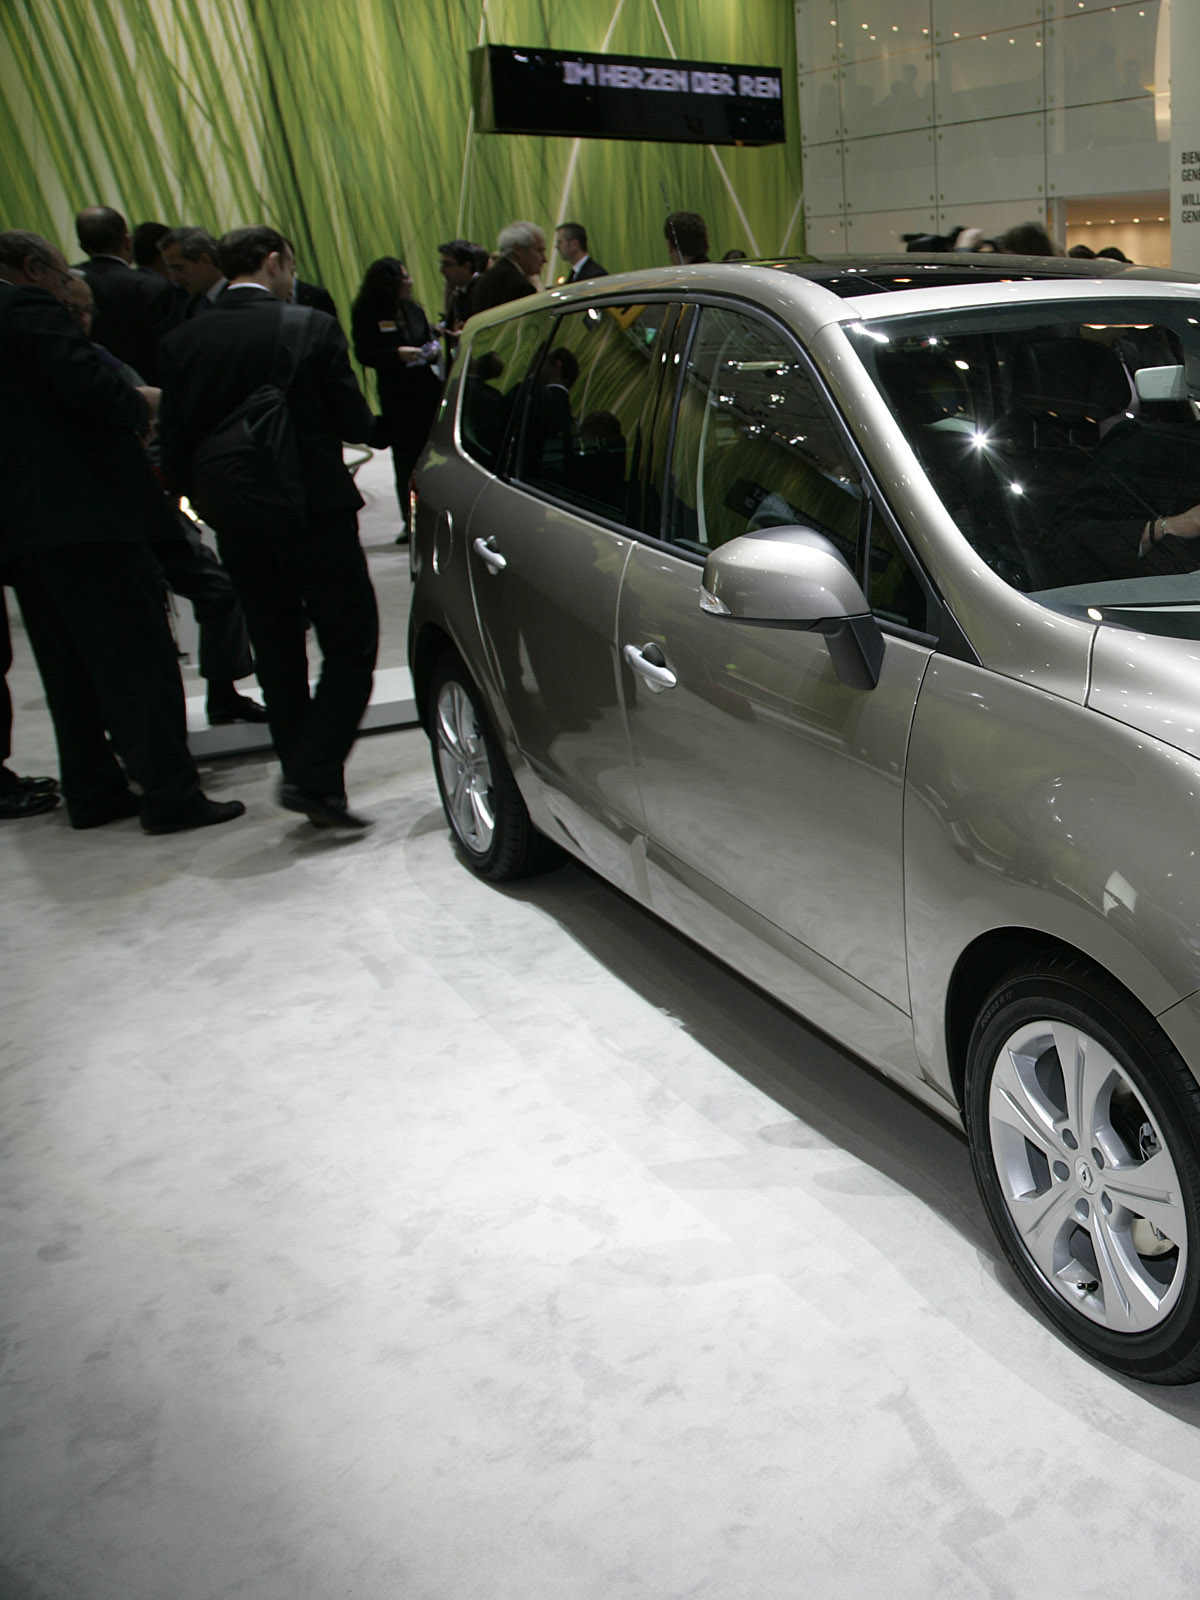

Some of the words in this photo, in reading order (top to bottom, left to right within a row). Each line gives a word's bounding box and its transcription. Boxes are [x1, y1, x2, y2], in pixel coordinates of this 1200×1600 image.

[564, 61, 595, 86] IM
[599, 64, 688, 93] HERZEN
[691, 71, 735, 96] DER
[739, 75, 781, 99] REN
